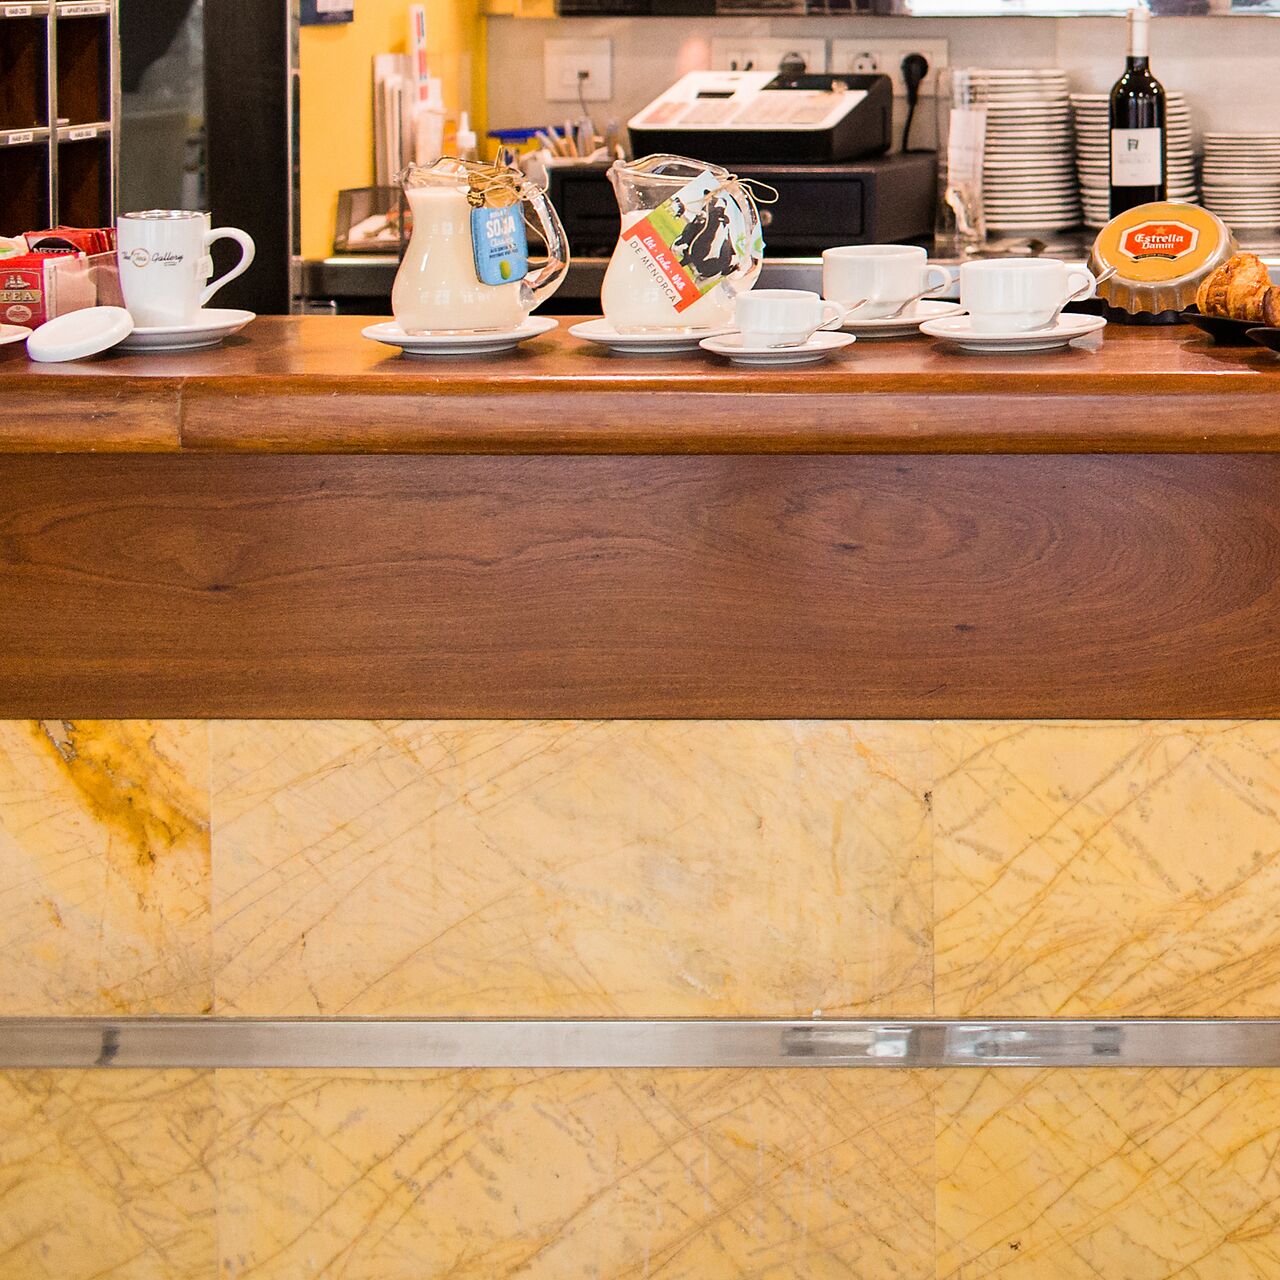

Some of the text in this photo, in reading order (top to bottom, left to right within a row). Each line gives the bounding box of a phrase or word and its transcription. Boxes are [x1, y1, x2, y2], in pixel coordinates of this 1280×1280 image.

[1134, 233, 1184, 243] Estrella
[1141, 242, 1175, 250] Damm
[151, 251, 184, 263] Gallery
[629, 240, 677, 302] DE MENORCA
[0, 291, 36, 302] TEA
